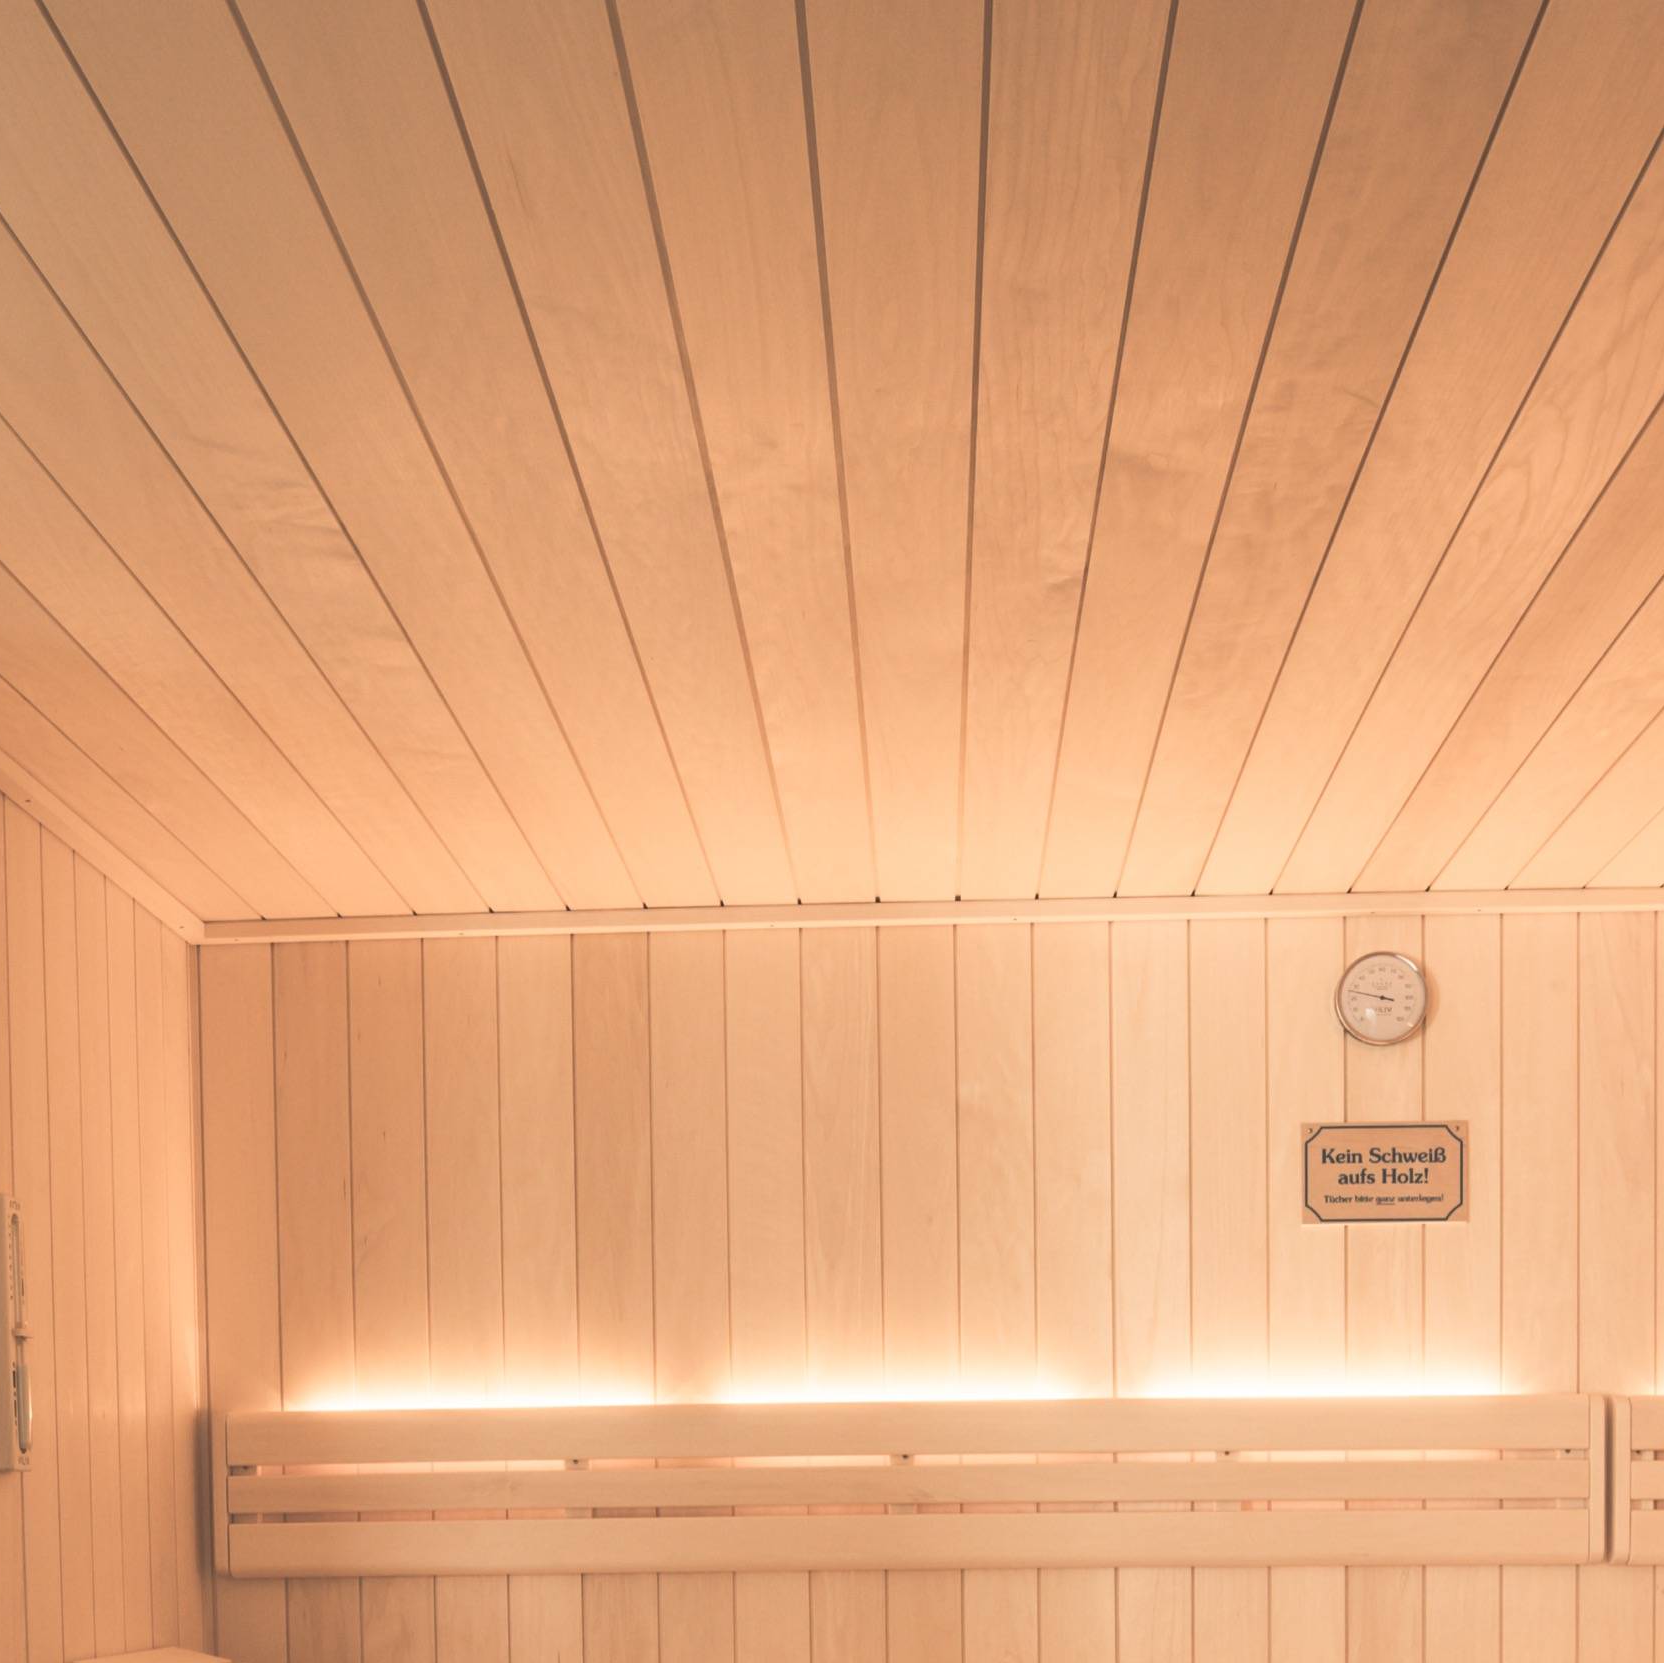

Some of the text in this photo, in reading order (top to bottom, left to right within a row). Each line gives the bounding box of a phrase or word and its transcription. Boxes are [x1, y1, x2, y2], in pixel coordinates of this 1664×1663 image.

[1321, 1146, 1447, 1164] Kein Schweiß
[1337, 1167, 1430, 1185] aufs Holz!
[1323, 1194, 1353, 1204] Tücher
